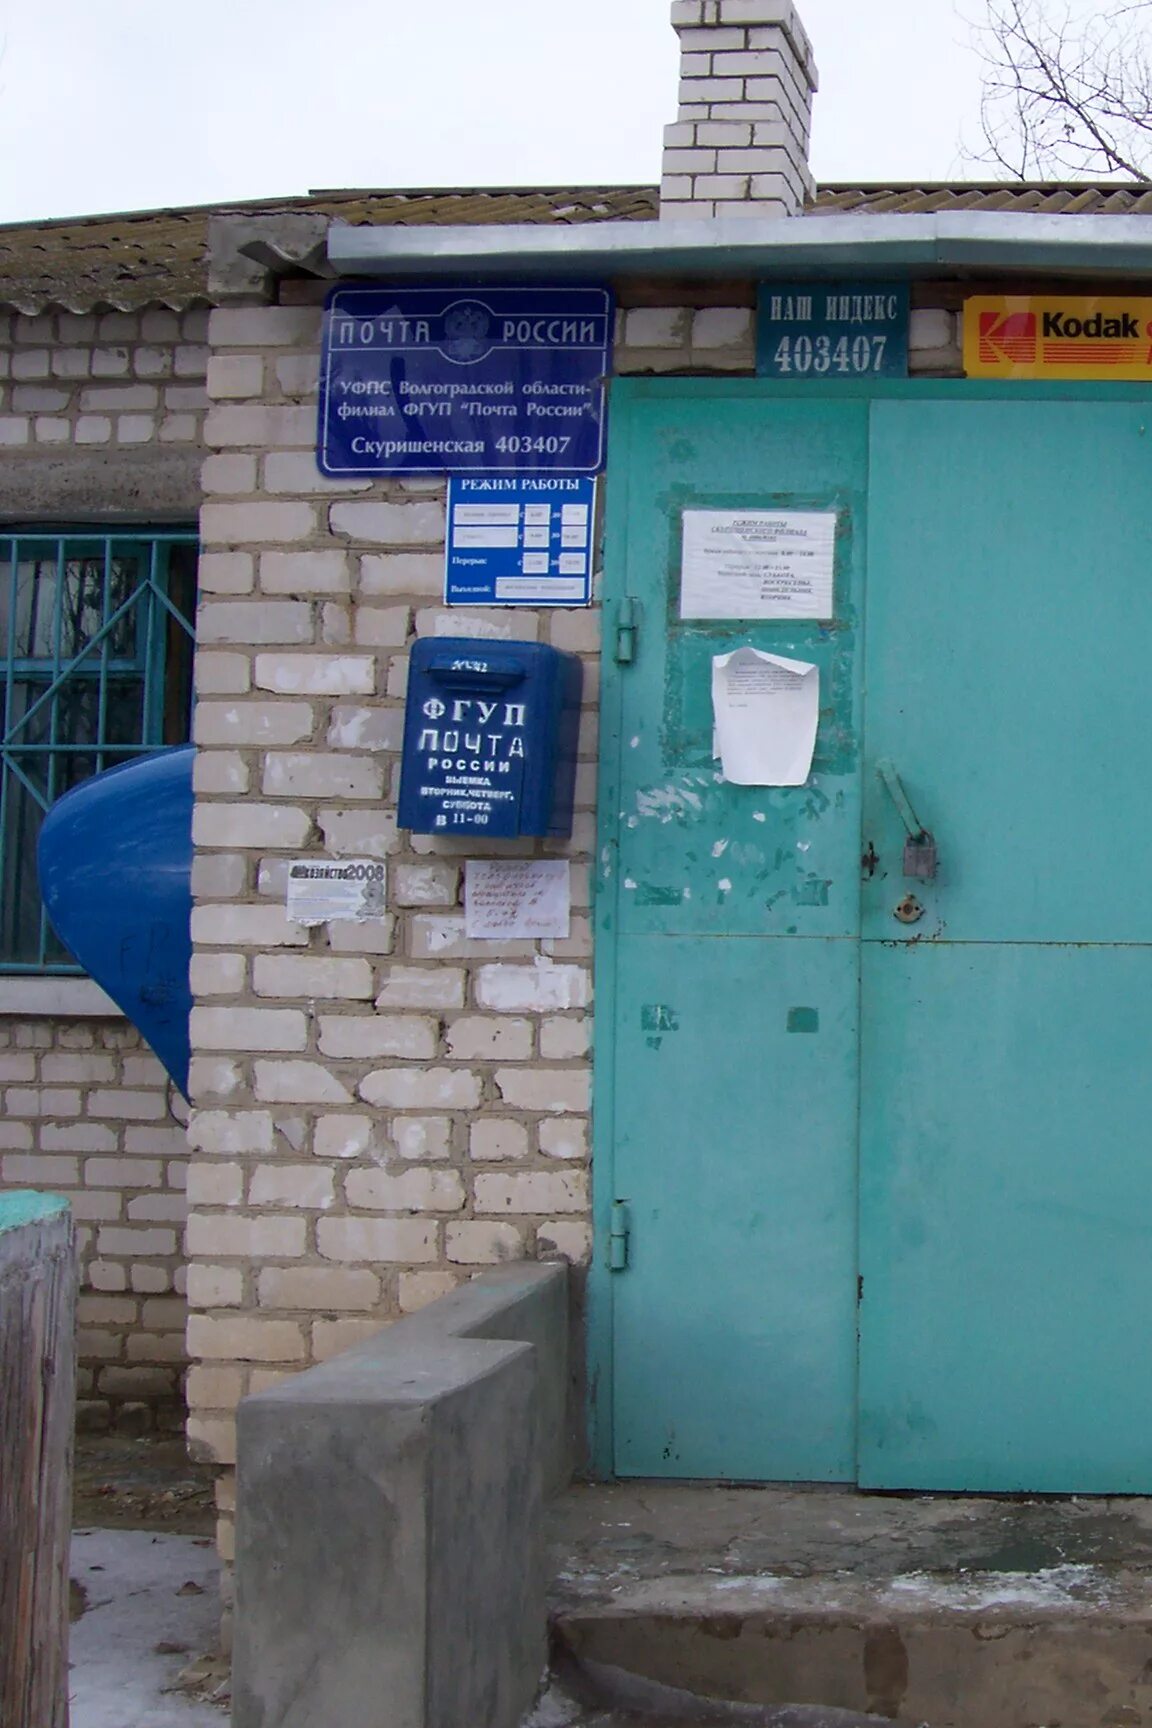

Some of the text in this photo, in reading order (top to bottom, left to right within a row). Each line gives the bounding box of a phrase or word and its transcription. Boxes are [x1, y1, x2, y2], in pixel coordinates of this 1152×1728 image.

[771, 294, 897, 325] НАШ ИНДЕКС
[339, 320, 595, 344] ПОЧТА РОССИИ
[1043, 312, 1140, 339] Kodak
[773, 335, 888, 373] 403407
[340, 381, 391, 396] УФПС
[399, 382, 514, 398] Волгоградской
[337, 403, 395, 420] филиал
[403, 402, 451, 417] ФГУП
[351, 436, 571, 458] Скуришенская 403407
[461, 479, 580, 491] РЕЖИМ РАБОТЫ
[423, 698, 526, 726] ФГУП
[418, 730, 524, 758] ПОЧТА
[428, 758, 510, 772] РОССИИ
[445, 776, 491, 786] ВЫЕМКА
[443, 801, 491, 810] СУББОТА
[436, 813, 489, 826] В 11-00
[348, 864, 384, 880] 2008
